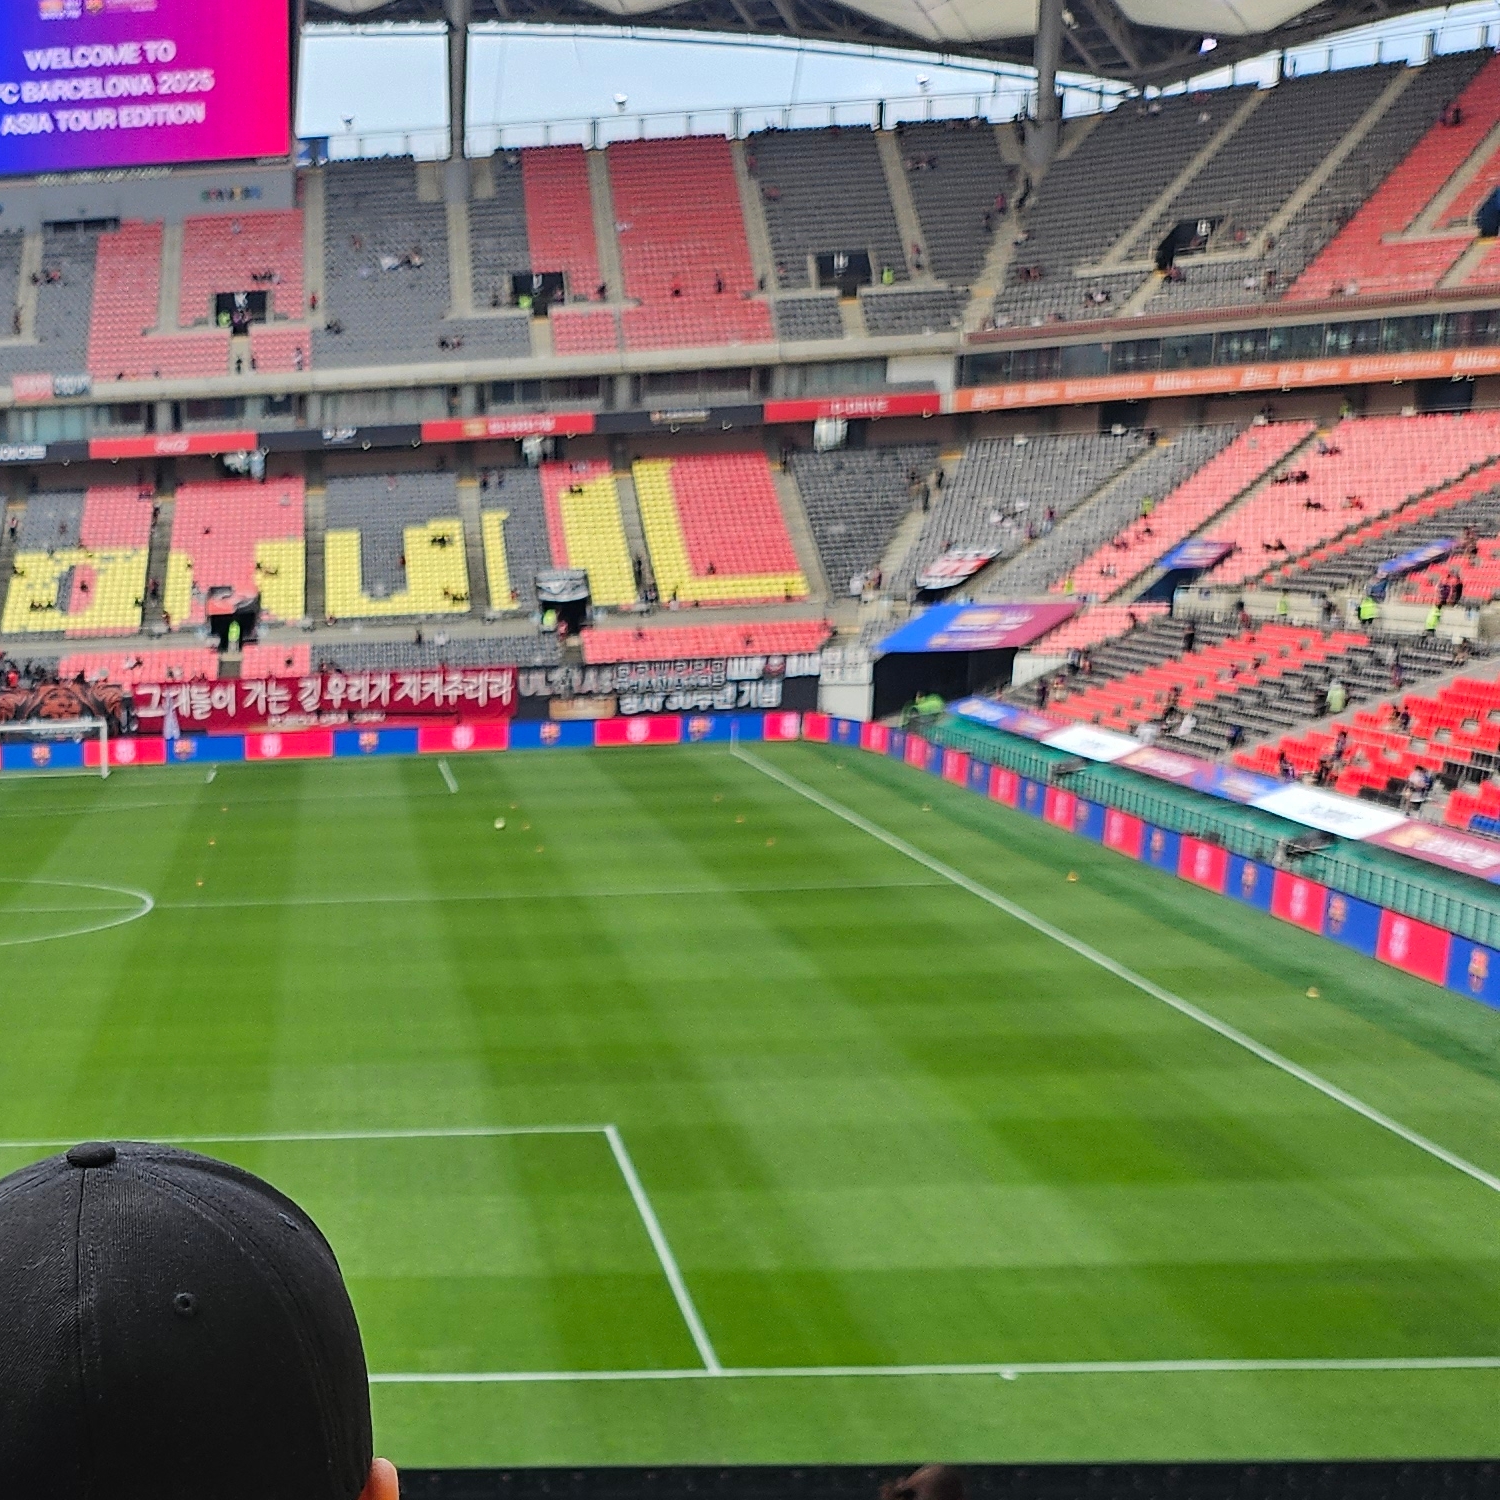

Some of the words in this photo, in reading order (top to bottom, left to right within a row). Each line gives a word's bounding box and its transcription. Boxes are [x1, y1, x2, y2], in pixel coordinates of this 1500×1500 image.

[23, 43, 142, 71] WELCOME
[143, 40, 177, 63] TO
[20, 74, 155, 103] BARCELONA
[156, 68, 216, 95] 2025
[1, 112, 54, 136] ASIA
[54, 107, 117, 132] TOUR
[117, 102, 206, 128] EDITION
